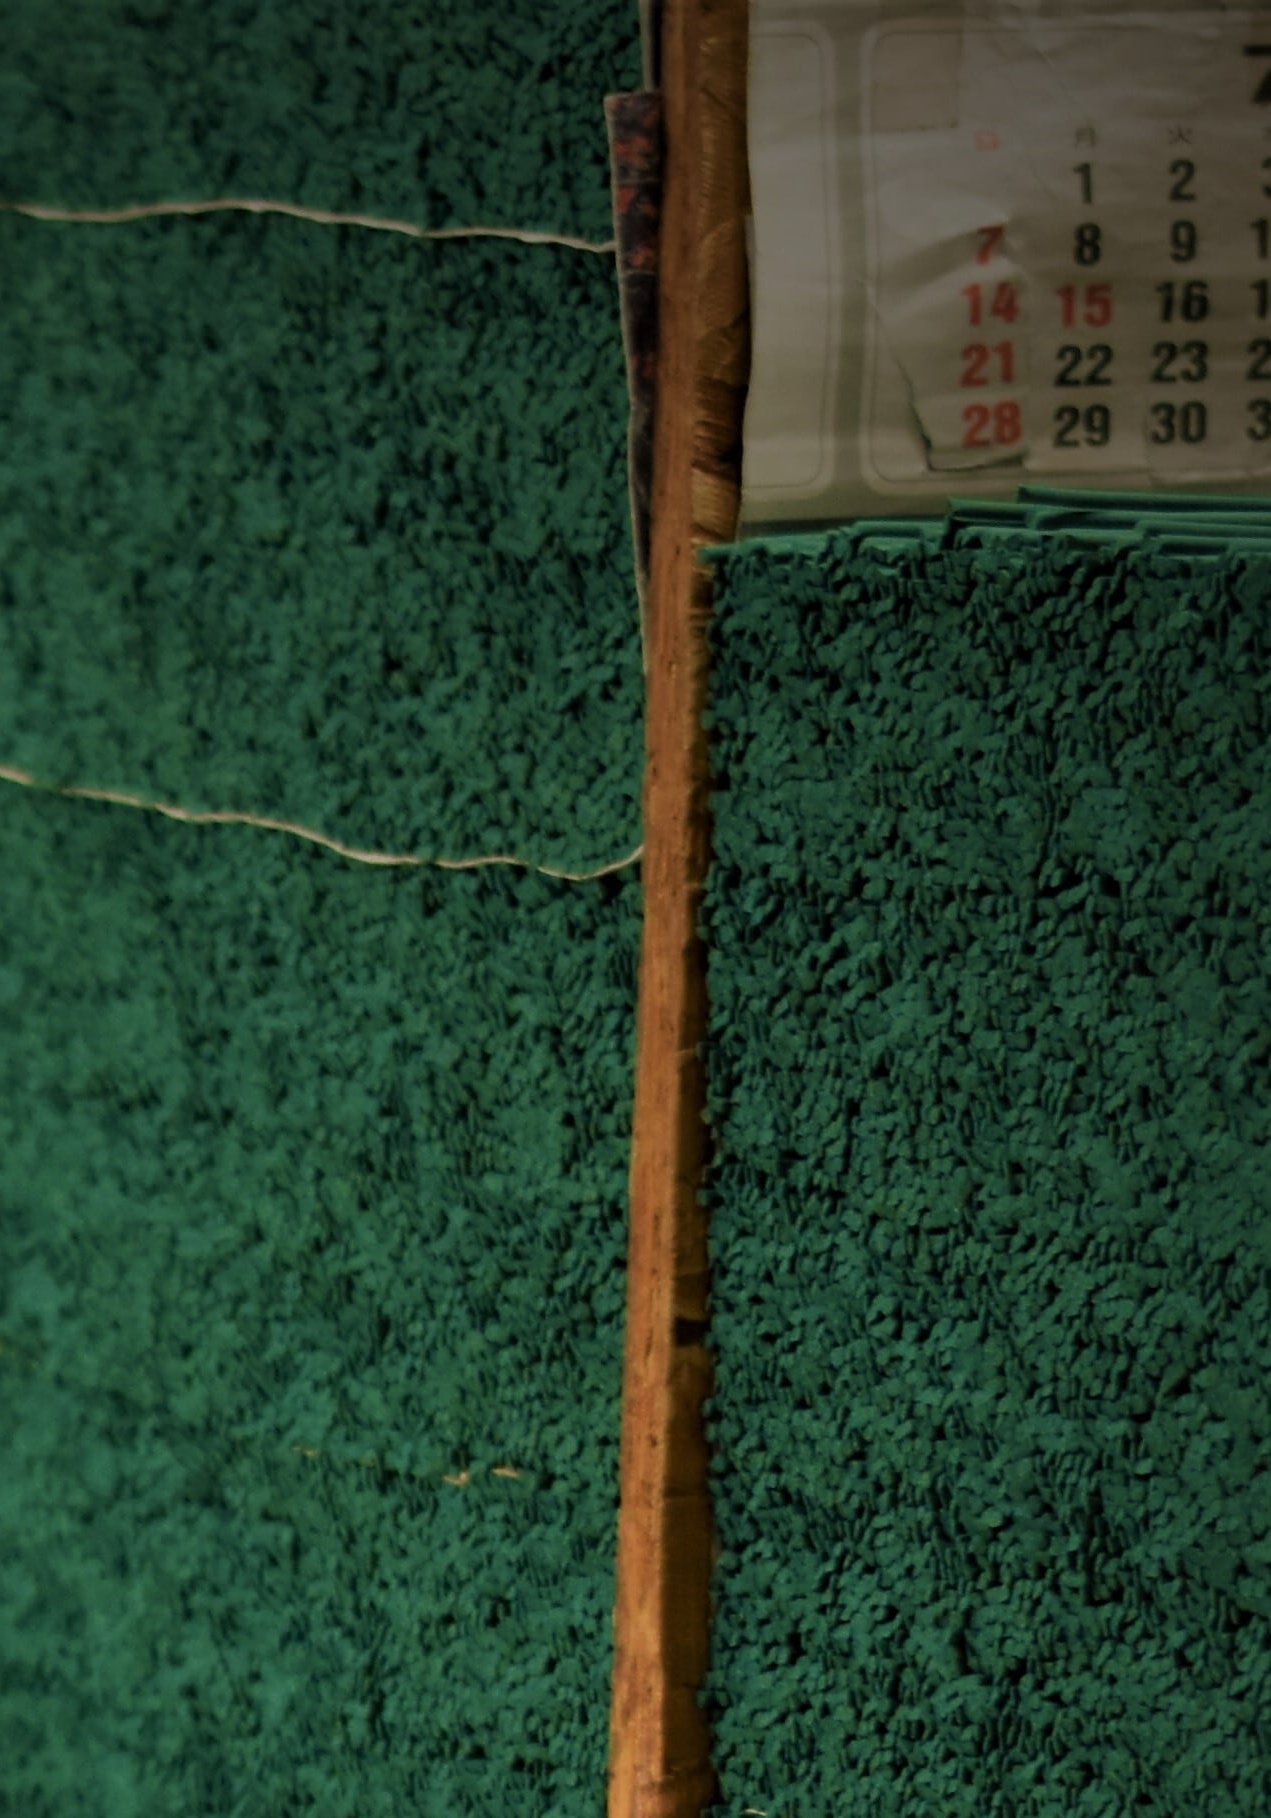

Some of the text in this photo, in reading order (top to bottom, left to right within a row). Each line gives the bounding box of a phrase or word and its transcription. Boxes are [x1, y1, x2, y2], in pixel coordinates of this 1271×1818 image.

[1168, 125, 1193, 145] 火
[1074, 159, 1196, 204] 1 2
[976, 224, 1005, 265] 7
[1074, 222, 1101, 266] 8
[1170, 219, 1197, 263] 9
[961, 283, 1019, 326] 14
[1057, 282, 1113, 327] 15
[1157, 280, 1209, 322] 16
[960, 341, 1015, 387] 21
[1053, 344, 1113, 387] 22
[1150, 340, 1208, 383] 23
[962, 399, 1022, 447] 28
[1053, 403, 1111, 447] 29
[1151, 400, 1207, 444] 30
